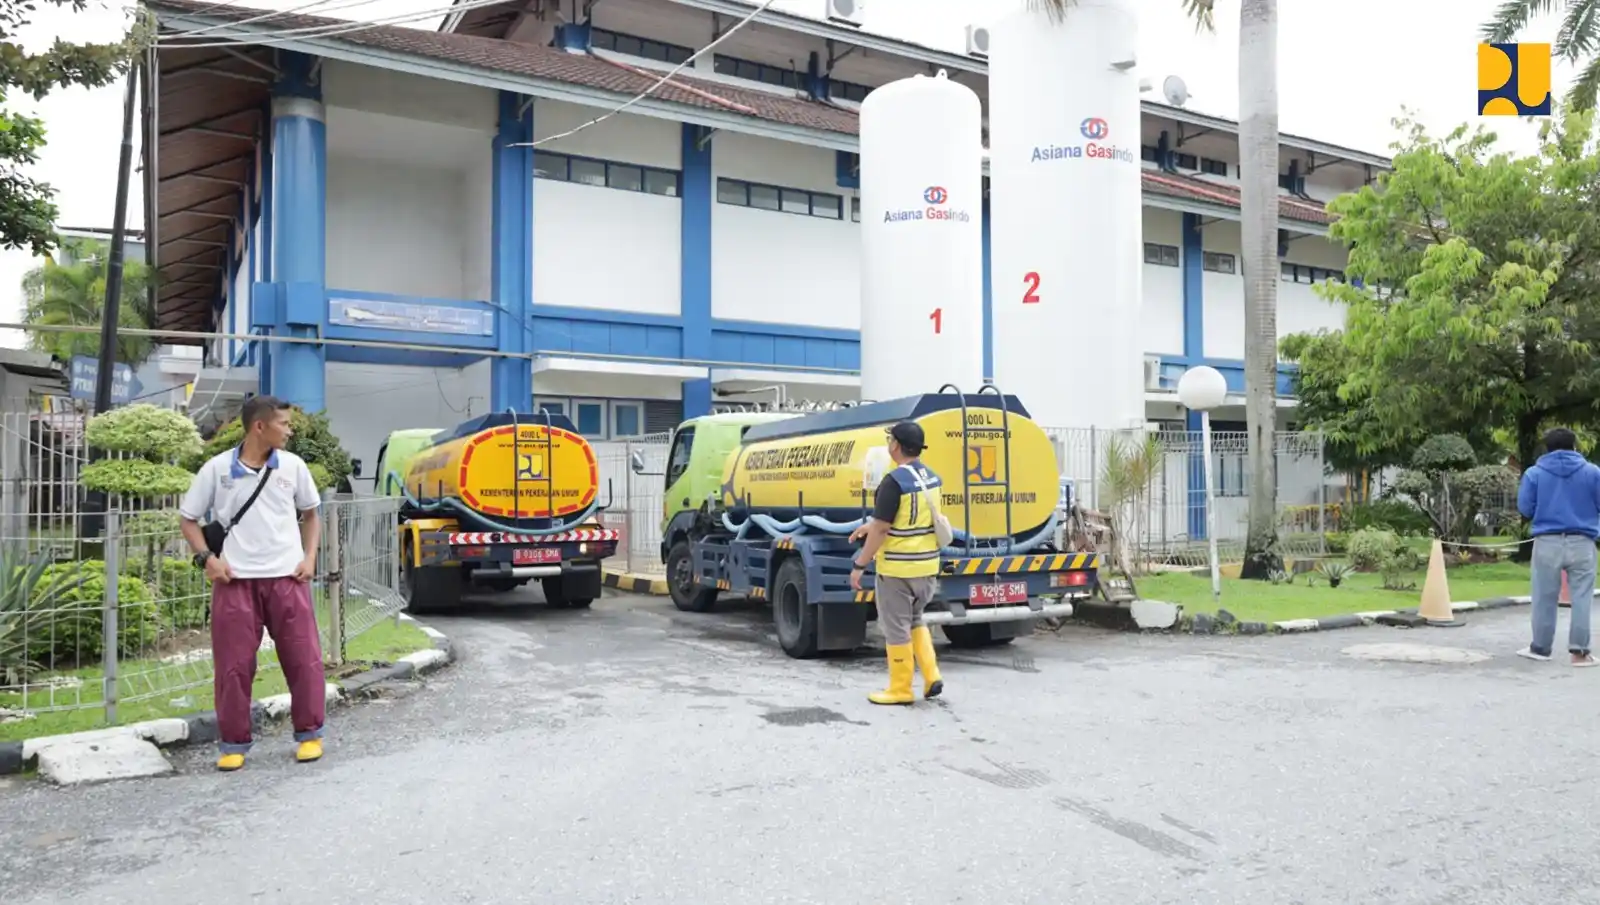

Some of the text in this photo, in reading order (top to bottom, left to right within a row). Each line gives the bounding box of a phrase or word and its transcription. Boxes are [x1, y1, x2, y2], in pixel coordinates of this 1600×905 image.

[1031, 142, 1134, 163] Asiana Gasindo
[884, 206, 969, 223] Asiana Gasindo
[1022, 272, 1041, 304] 2
[929, 308, 942, 334] 1
[965, 414, 993, 426] 000 L
[480, 488, 523, 497] KEMENTERN
[525, 489, 560, 498] PEKERJAN
[971, 586, 978, 599] B
[1009, 583, 1026, 597] SMA
